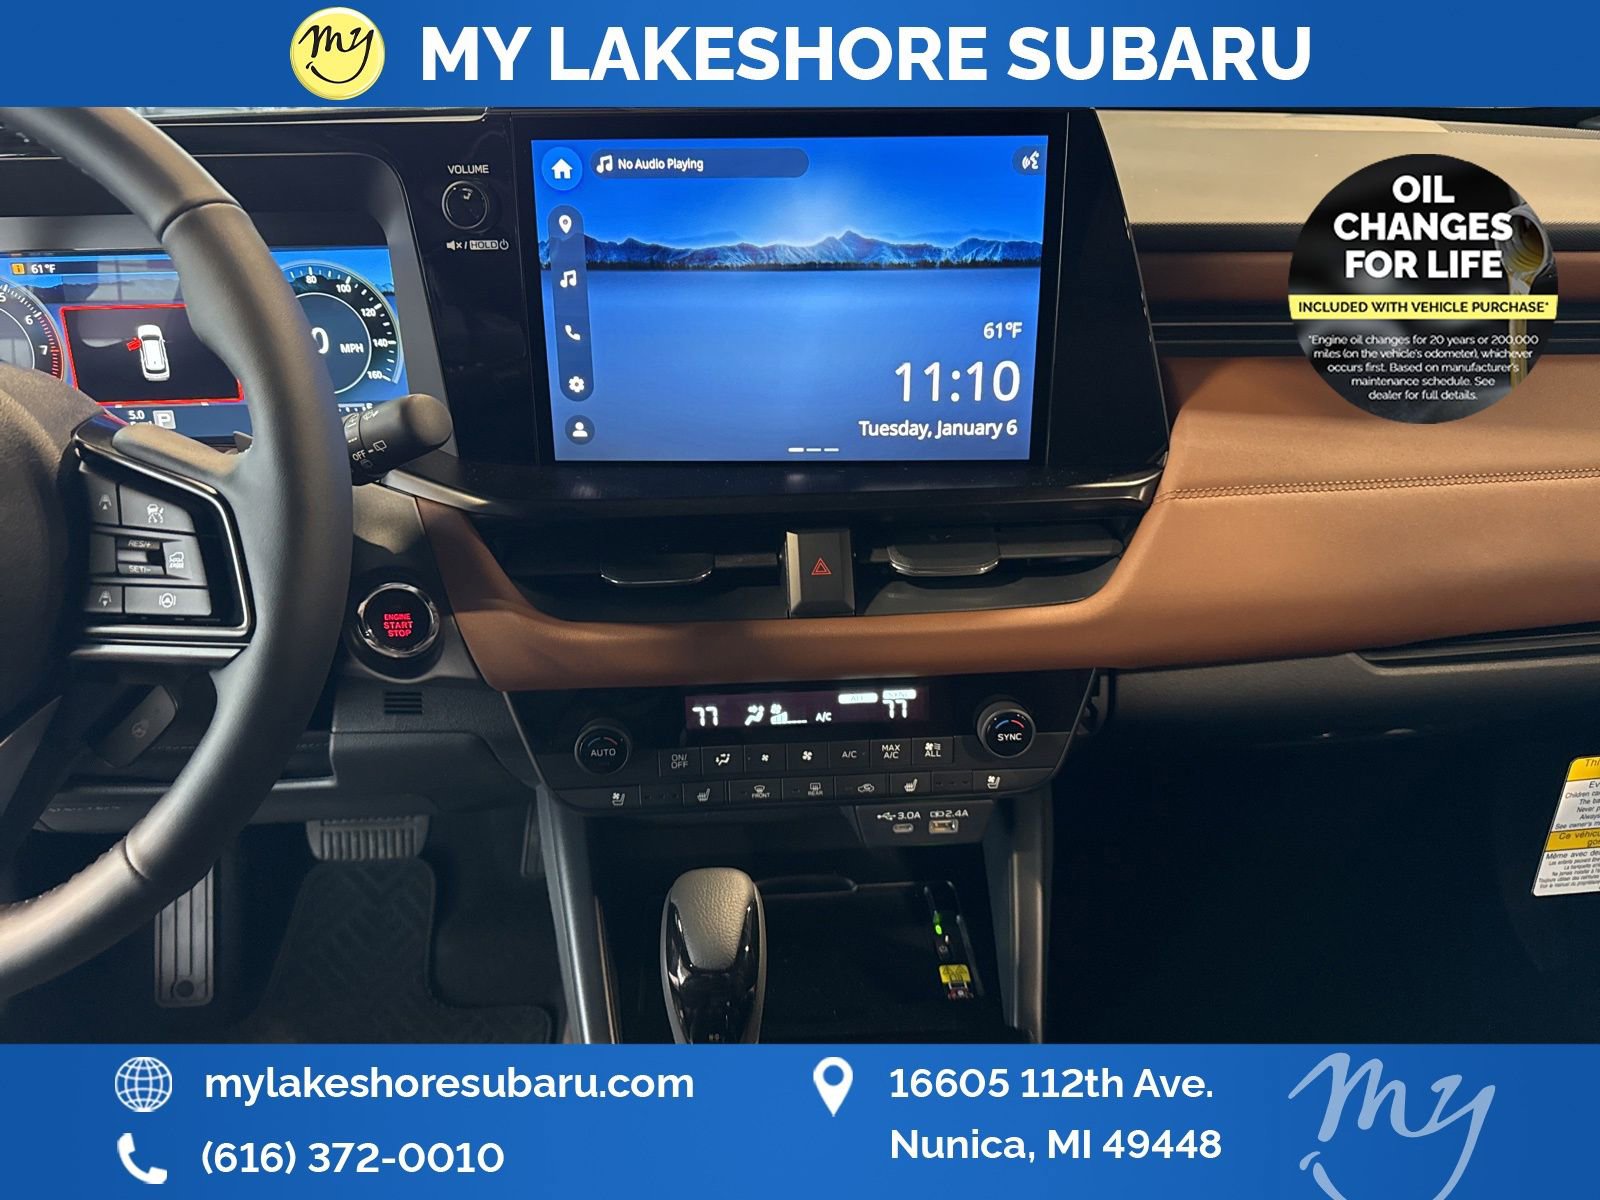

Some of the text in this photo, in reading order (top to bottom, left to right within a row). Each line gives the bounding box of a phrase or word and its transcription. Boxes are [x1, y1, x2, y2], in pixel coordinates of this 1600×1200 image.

[447, 164, 490, 175] VOLUME
[618, 158, 704, 172] No Audio Playing
[469, 240, 499, 250] HOLD
[31, 263, 56, 274] 61°F
[305, 275, 317, 284] 80
[335, 284, 352, 293] 100
[360, 307, 377, 317] 120
[24, 314, 34, 325] 6
[983, 321, 1023, 340] 61°F
[372, 338, 388, 348] 140
[38, 344, 48, 356] 7
[340, 343, 364, 354] MPH
[366, 370, 383, 379] 160
[894, 359, 1021, 403] 11:10
[128, 409, 145, 420] 5.0
[858, 419, 1018, 440] Tuesday, January 6
[352, 449, 367, 461] OFF
[383, 613, 412, 621] ENGINE
[383, 621, 414, 630] START
[387, 629, 412, 638] STOP
[692, 706, 719, 727] 77
[815, 711, 833, 723] A/C
[997, 732, 1023, 742] SYNC
[590, 748, 616, 758] AUTO
[881, 744, 901, 752] MAX
[671, 753, 688, 761] ON/
[841, 750, 857, 759] A/C
[883, 751, 899, 760] A/C
[924, 750, 942, 758] ALL
[671, 761, 689, 769] OFF
[897, 811, 921, 820] 3.0A
[945, 809, 969, 819] 2.4A
